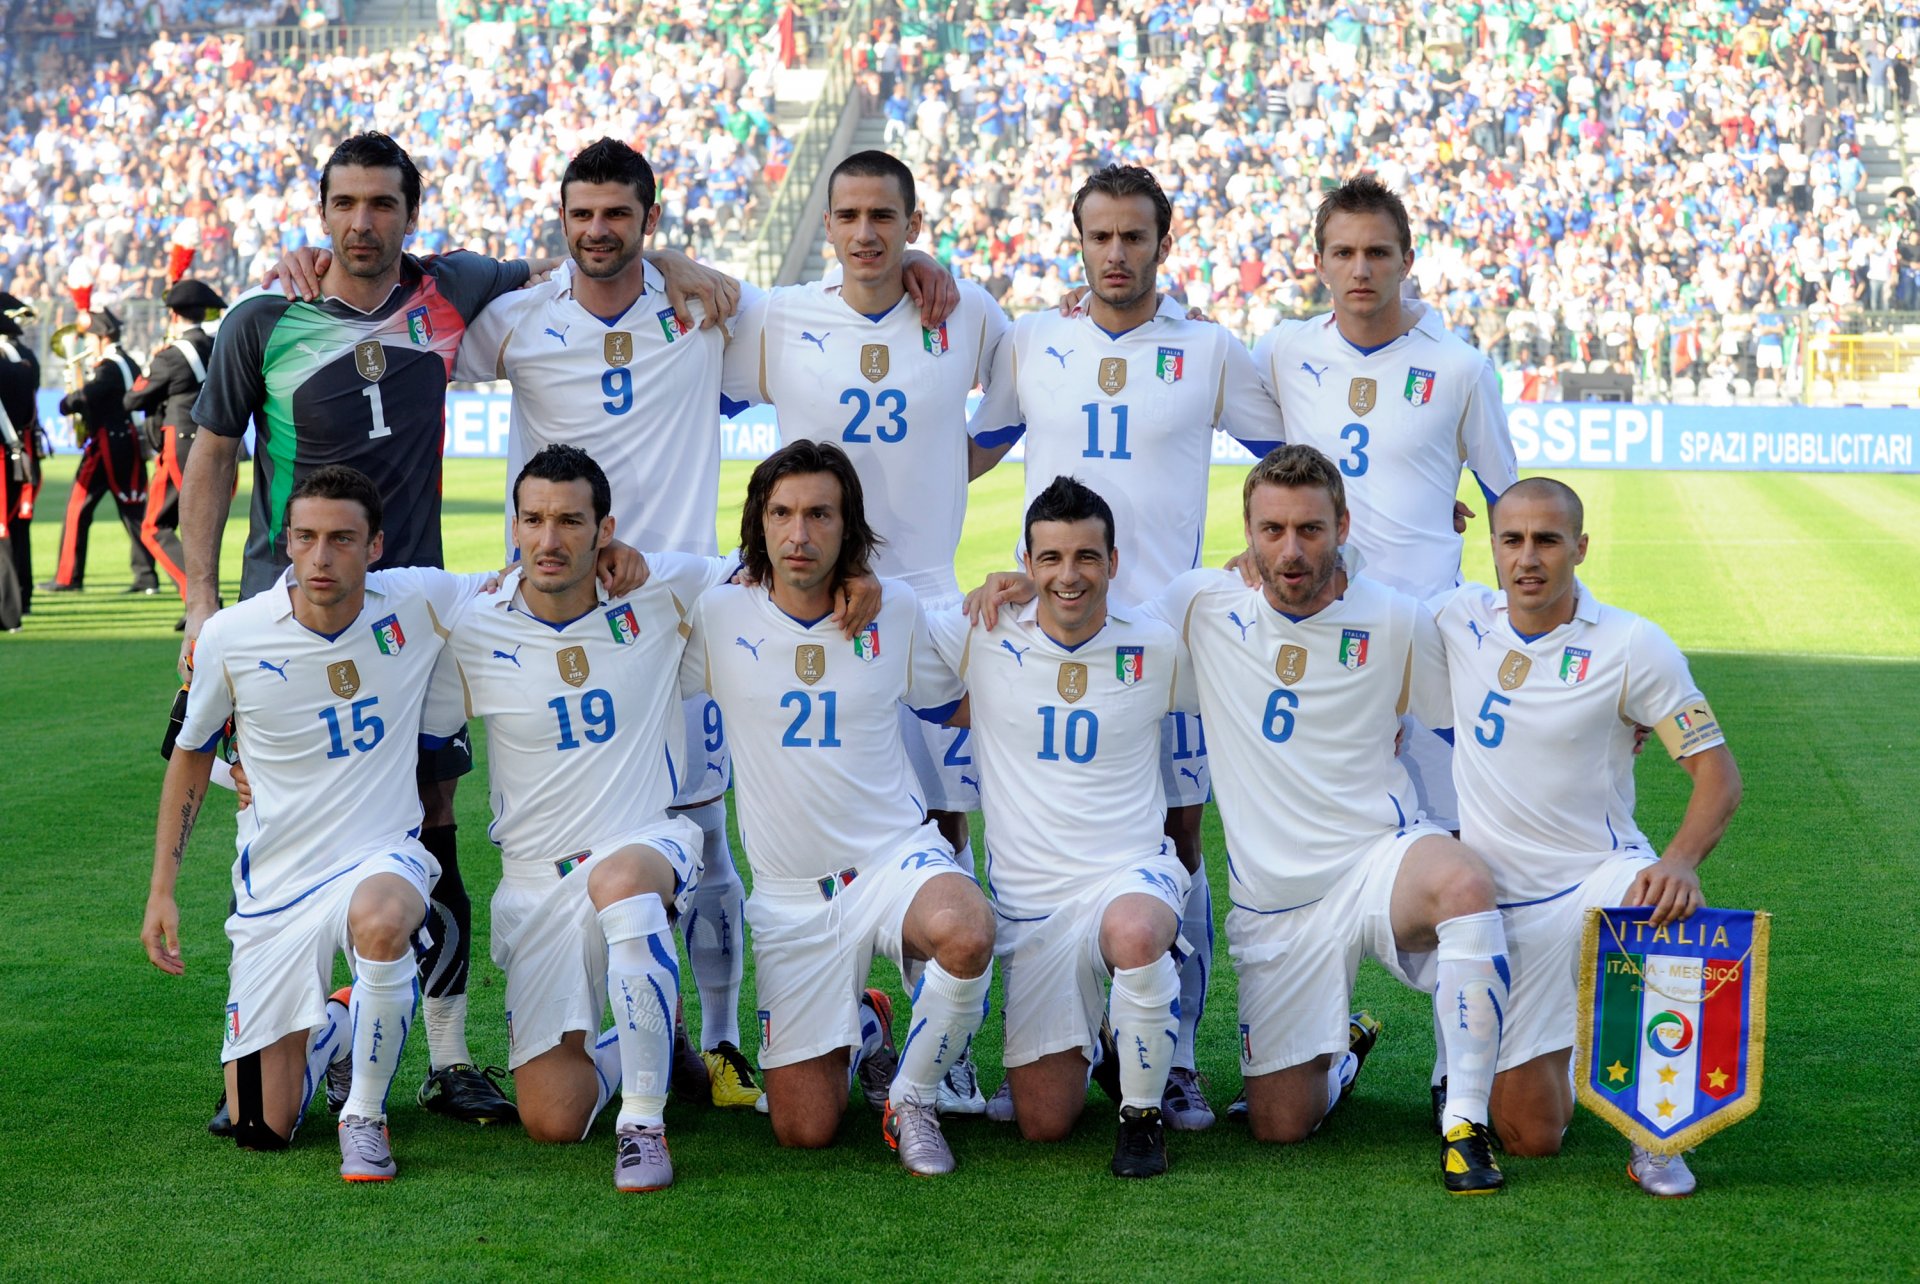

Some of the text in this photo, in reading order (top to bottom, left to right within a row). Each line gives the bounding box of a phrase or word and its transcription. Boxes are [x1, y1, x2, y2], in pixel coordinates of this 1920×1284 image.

[601, 367, 633, 416] 9
[1411, 370, 1433, 378] ITALIA
[362, 383, 392, 439] 1
[839, 388, 908, 443] 23
[1082, 403, 1132, 460] 11
[1339, 423, 1369, 477] 3
[1679, 431, 1747, 463] SPAZI
[1752, 432, 1912, 466] PUBBLICITARI
[608, 605, 629, 617] ITALIA
[569, 671, 583, 679] FIFA
[1567, 648, 1589, 657] ITALIA
[340, 684, 353, 692] FIFA
[318, 696, 385, 760] 15
[547, 688, 616, 751] 19
[703, 699, 723, 752] 9
[780, 690, 842, 748] 21
[1037, 706, 1099, 764] 10
[1262, 689, 1299, 743] 6
[1475, 690, 1511, 748] 5
[1619, 920, 1730, 948] ITALIA
[1606, 959, 1657, 977] ITALIA
[1668, 964, 1740, 983] MESSICO
[621, 978, 637, 1032] ITALIA
[369, 1017, 383, 1064] ITALIA
